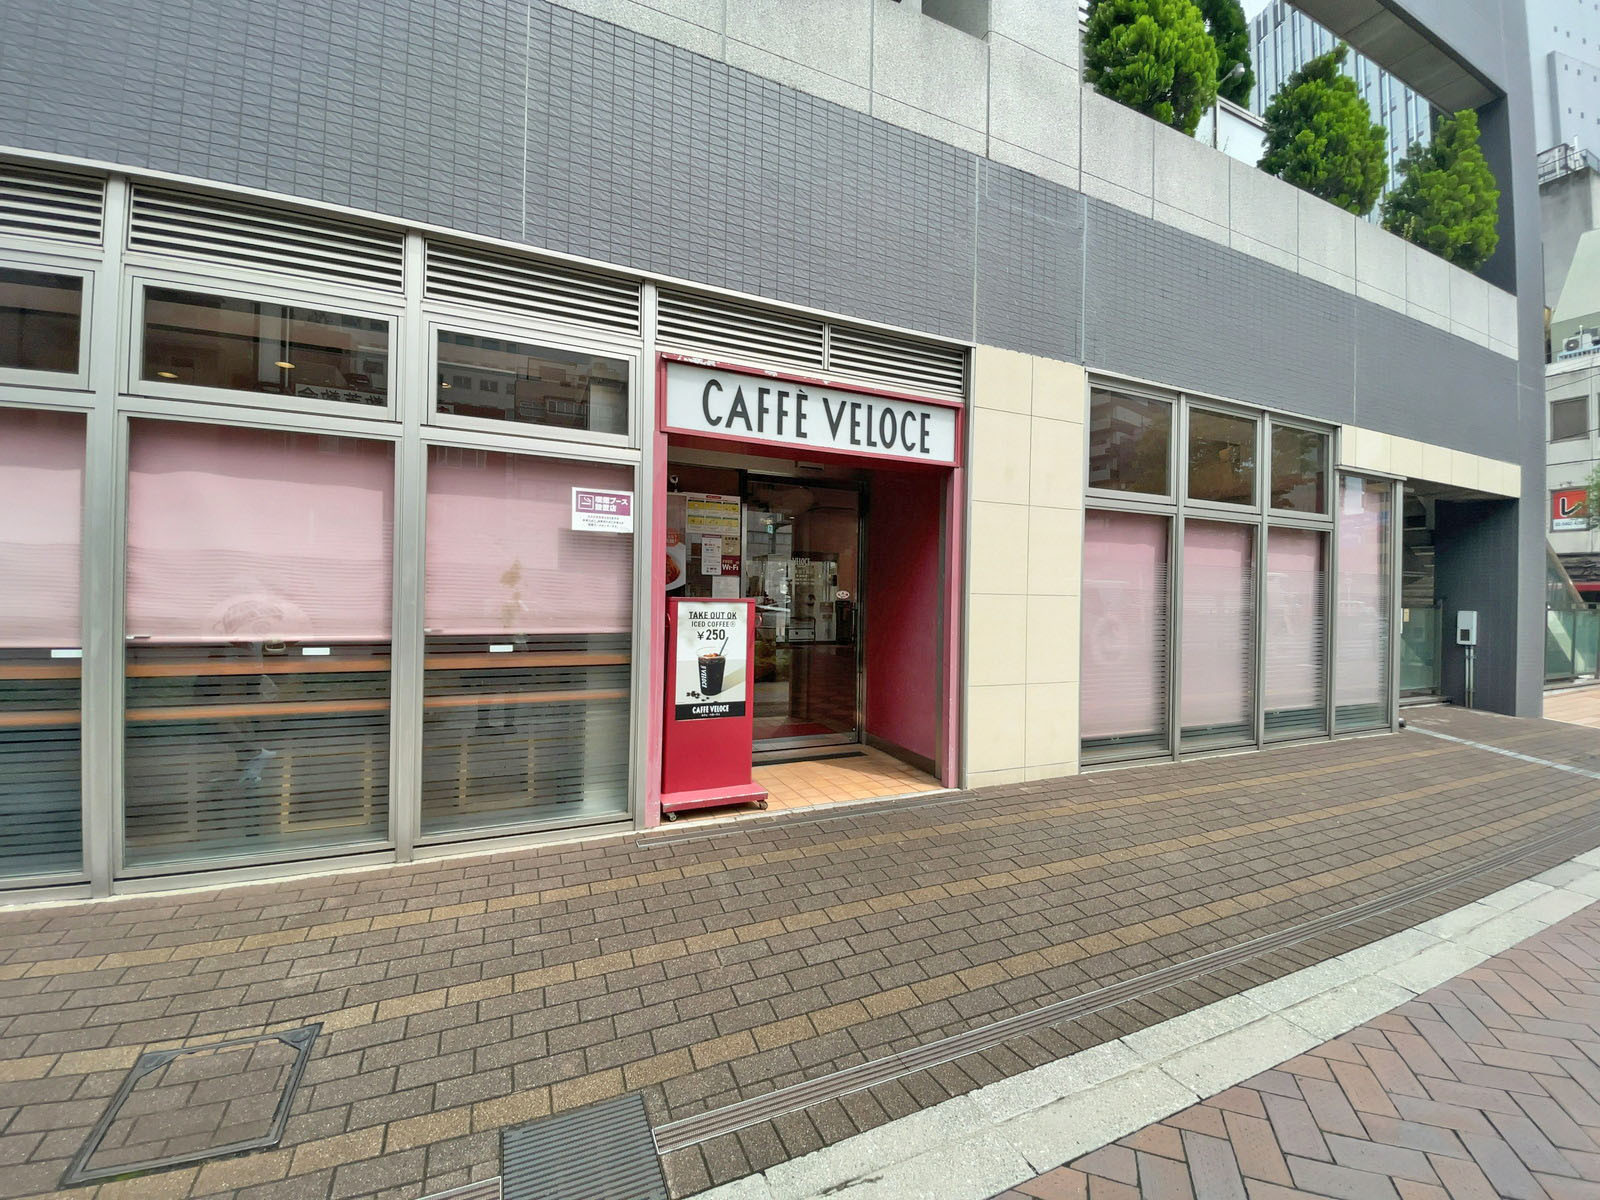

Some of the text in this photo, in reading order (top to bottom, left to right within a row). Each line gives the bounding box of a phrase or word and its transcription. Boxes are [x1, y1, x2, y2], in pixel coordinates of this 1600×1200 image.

[702, 378, 931, 454] CAFFÈ VELOCE
[688, 611, 737, 620] TAKE OUT OK
[691, 620, 729, 628] ICED COFFEE
[709, 704, 729, 713] VELOCE
